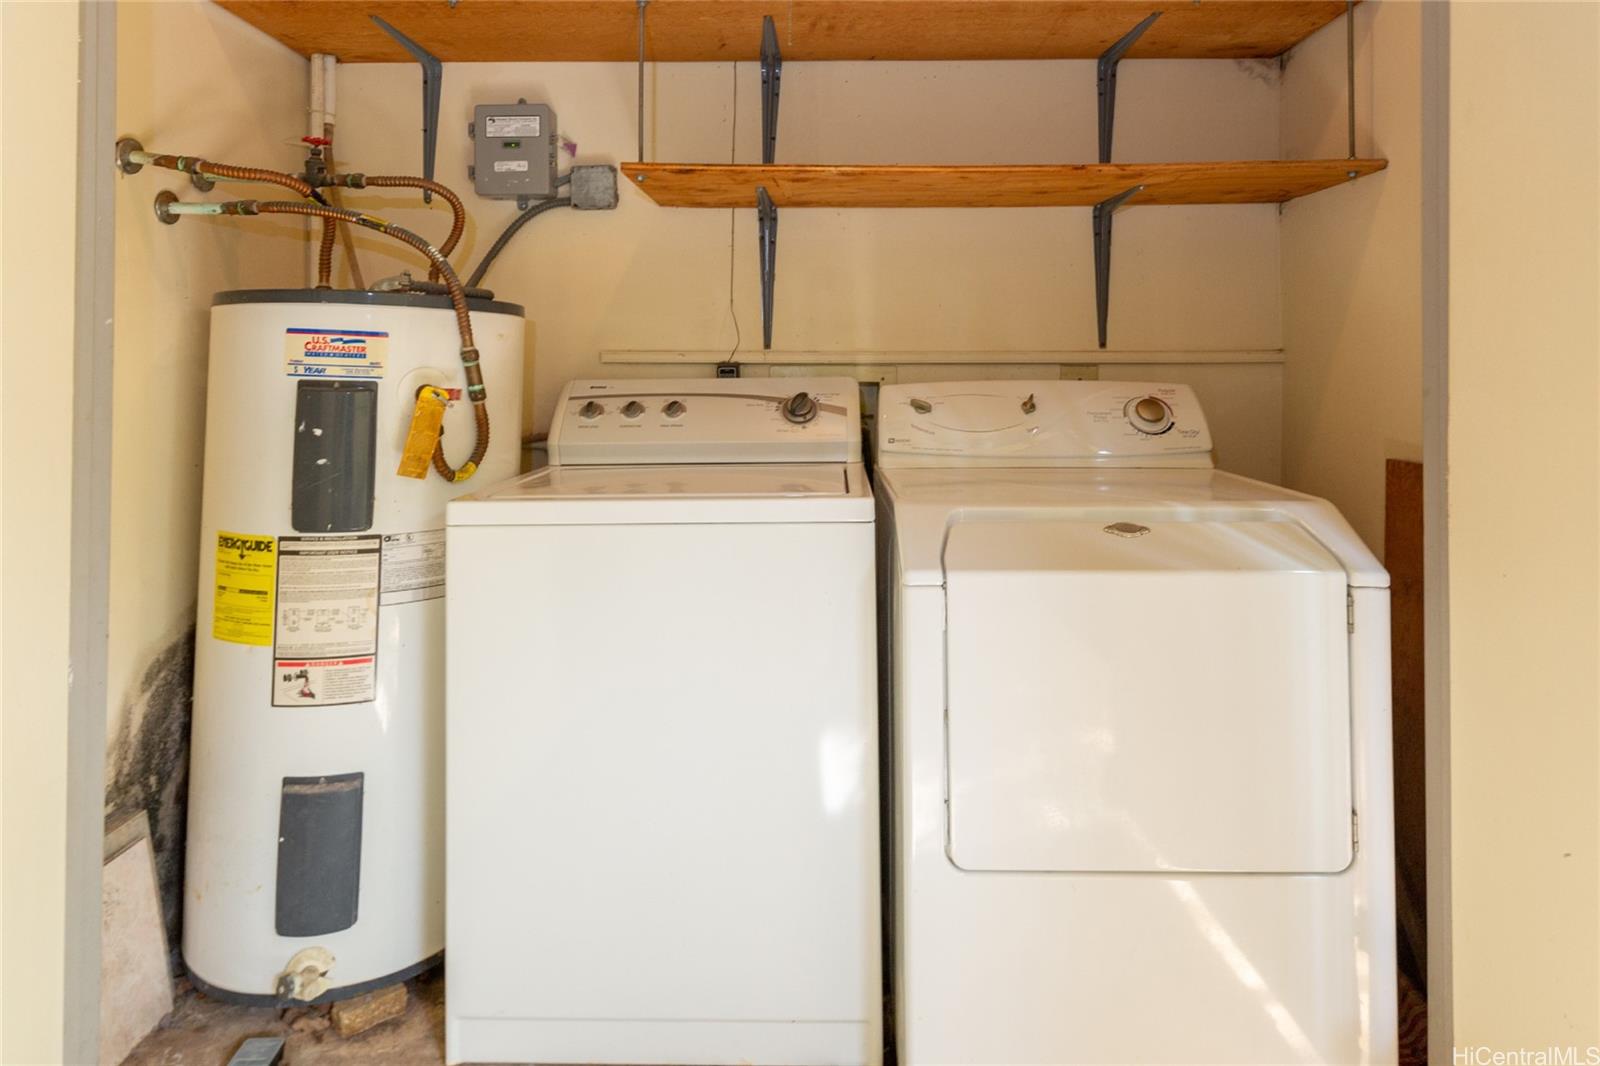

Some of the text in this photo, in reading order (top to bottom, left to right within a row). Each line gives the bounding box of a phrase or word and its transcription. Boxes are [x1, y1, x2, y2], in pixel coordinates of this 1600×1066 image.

[312, 336, 329, 344] U.S.
[304, 341, 367, 353] CRAFTMASTER
[304, 366, 326, 374] YEAR
